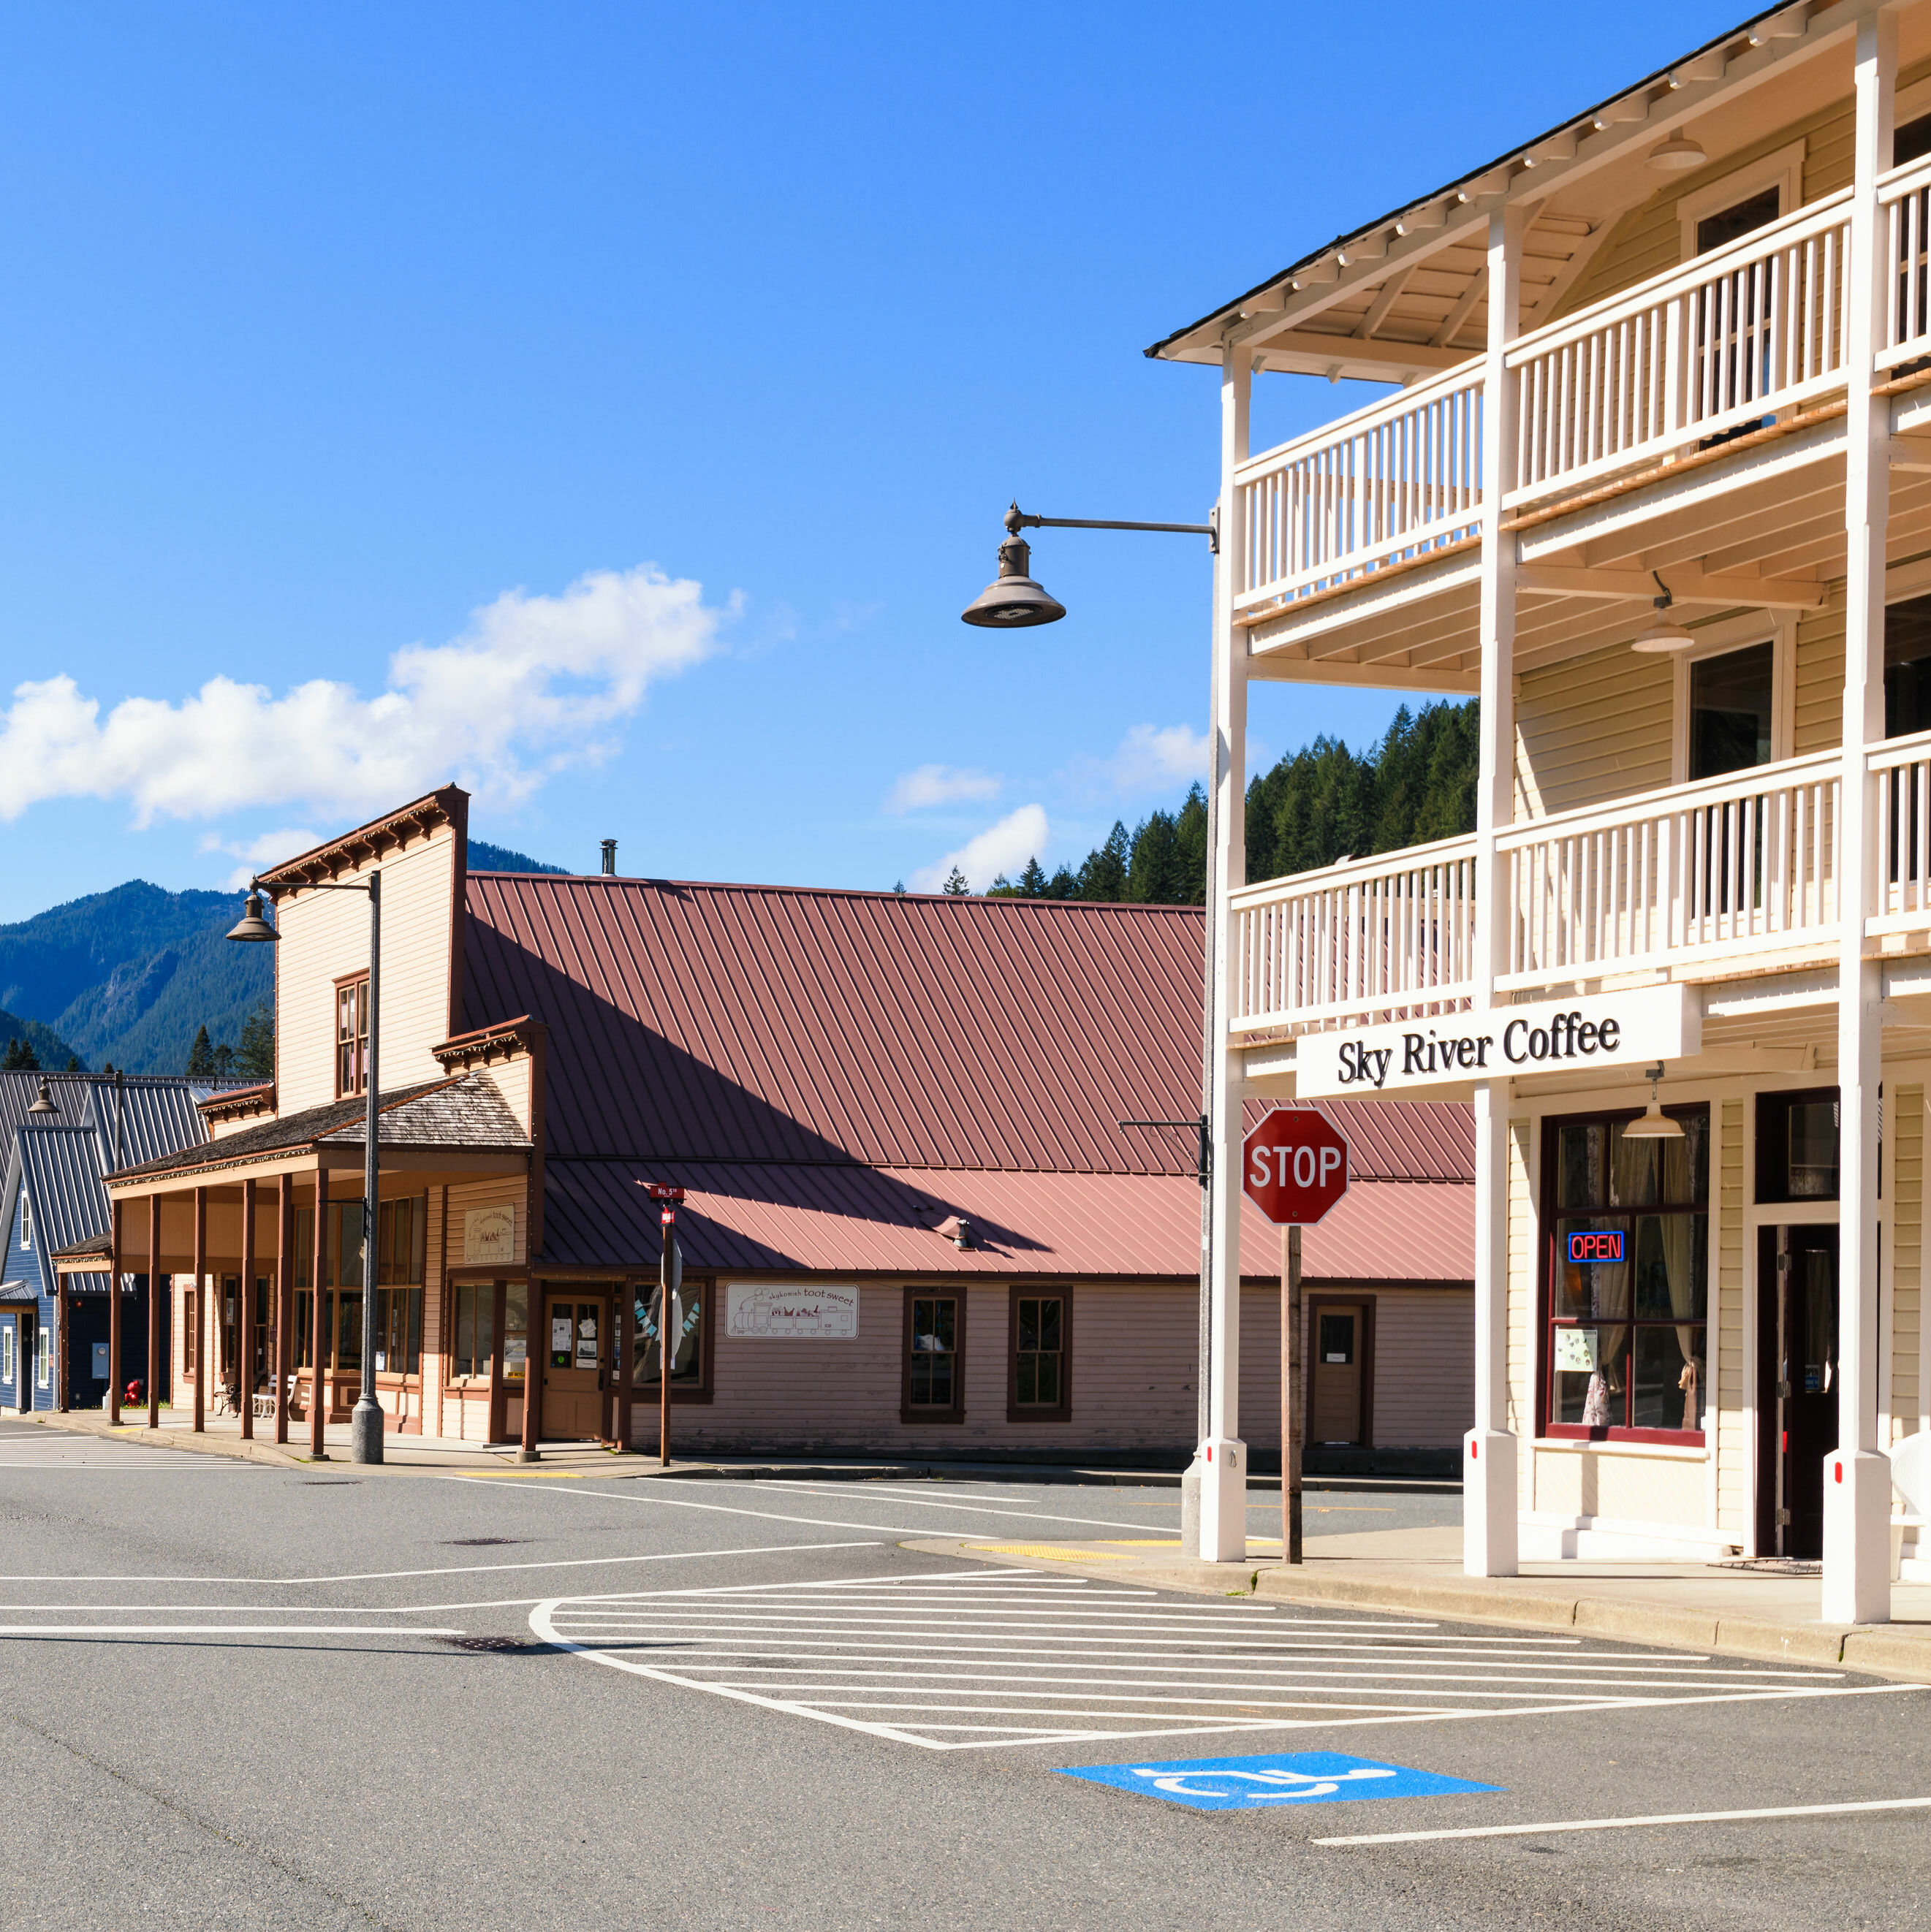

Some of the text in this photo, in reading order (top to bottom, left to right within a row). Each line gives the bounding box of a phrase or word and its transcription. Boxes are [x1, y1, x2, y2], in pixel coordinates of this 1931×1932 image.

[1338, 1011, 1620, 1089] Sky River Coffee
[1249, 1145, 1341, 1187] STOP
[658, 1187, 667, 1195] No.
[1571, 1234, 1621, 1259] OPEN
[769, 1288, 854, 1307] skykomish toot sweet
